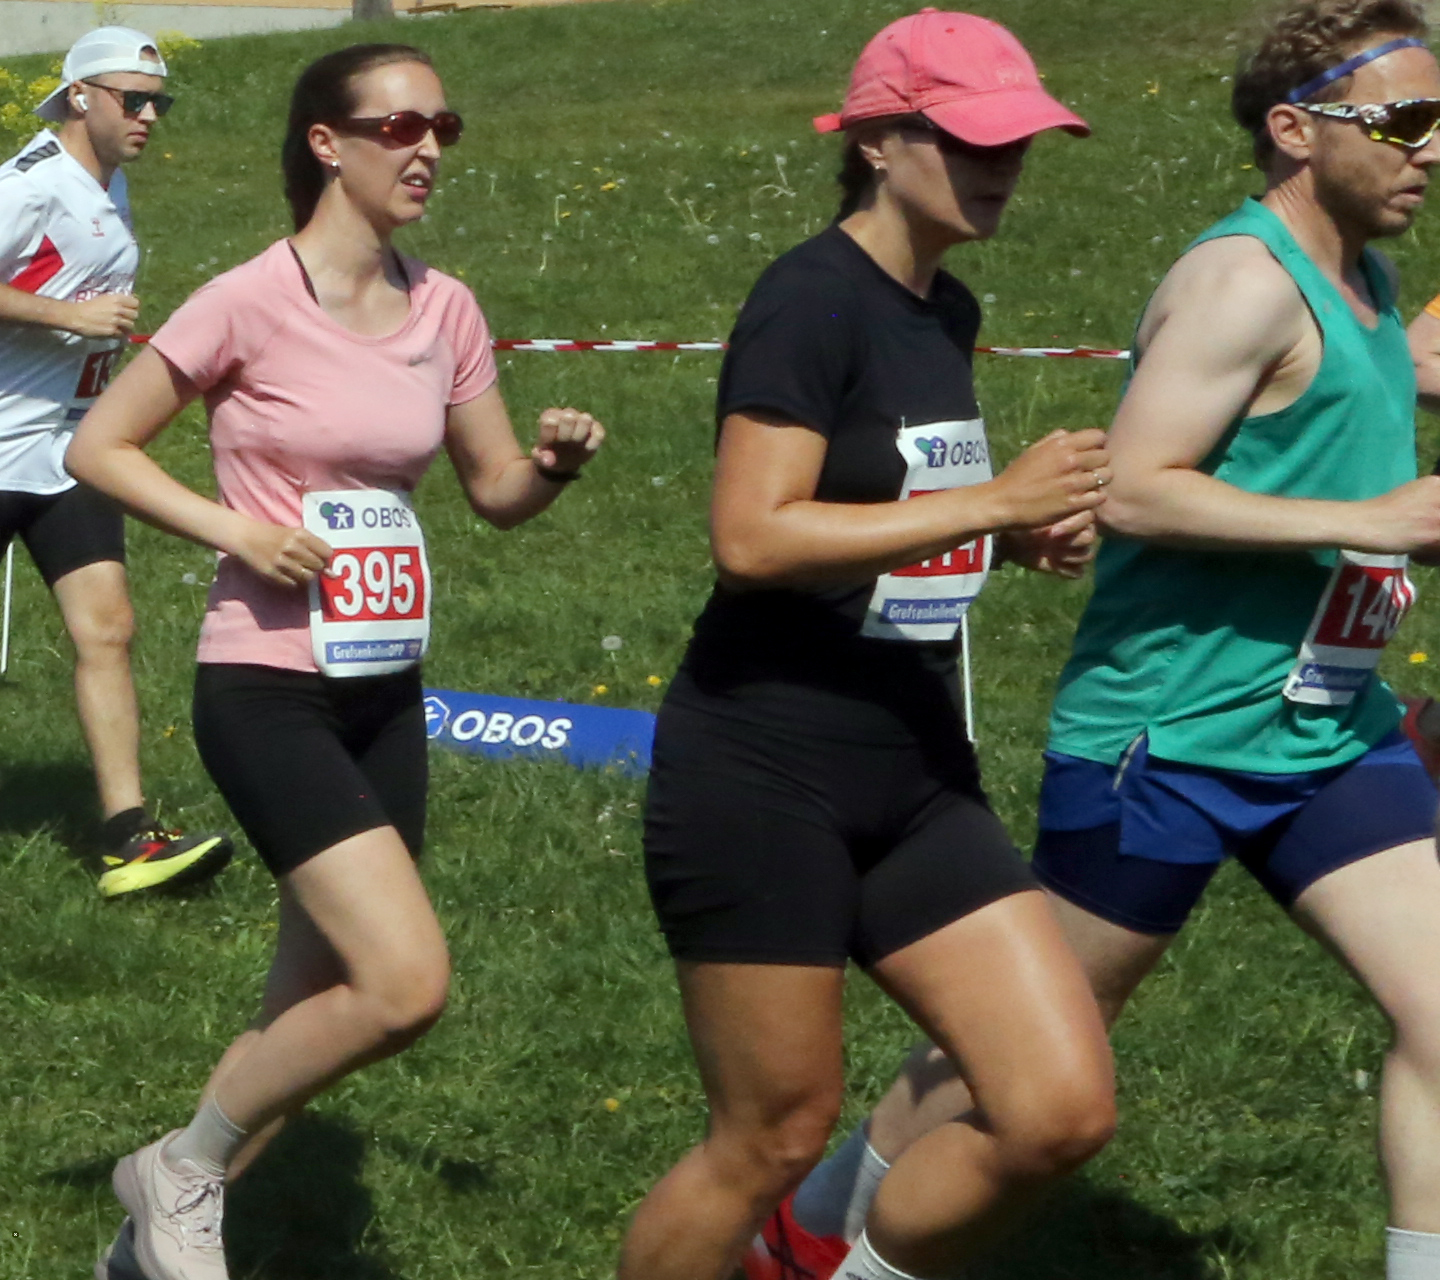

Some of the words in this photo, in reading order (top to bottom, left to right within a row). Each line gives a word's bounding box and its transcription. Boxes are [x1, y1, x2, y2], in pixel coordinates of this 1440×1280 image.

[362, 507, 412, 528] OBOS
[332, 550, 416, 617] 395
[451, 710, 572, 749] OBOS
